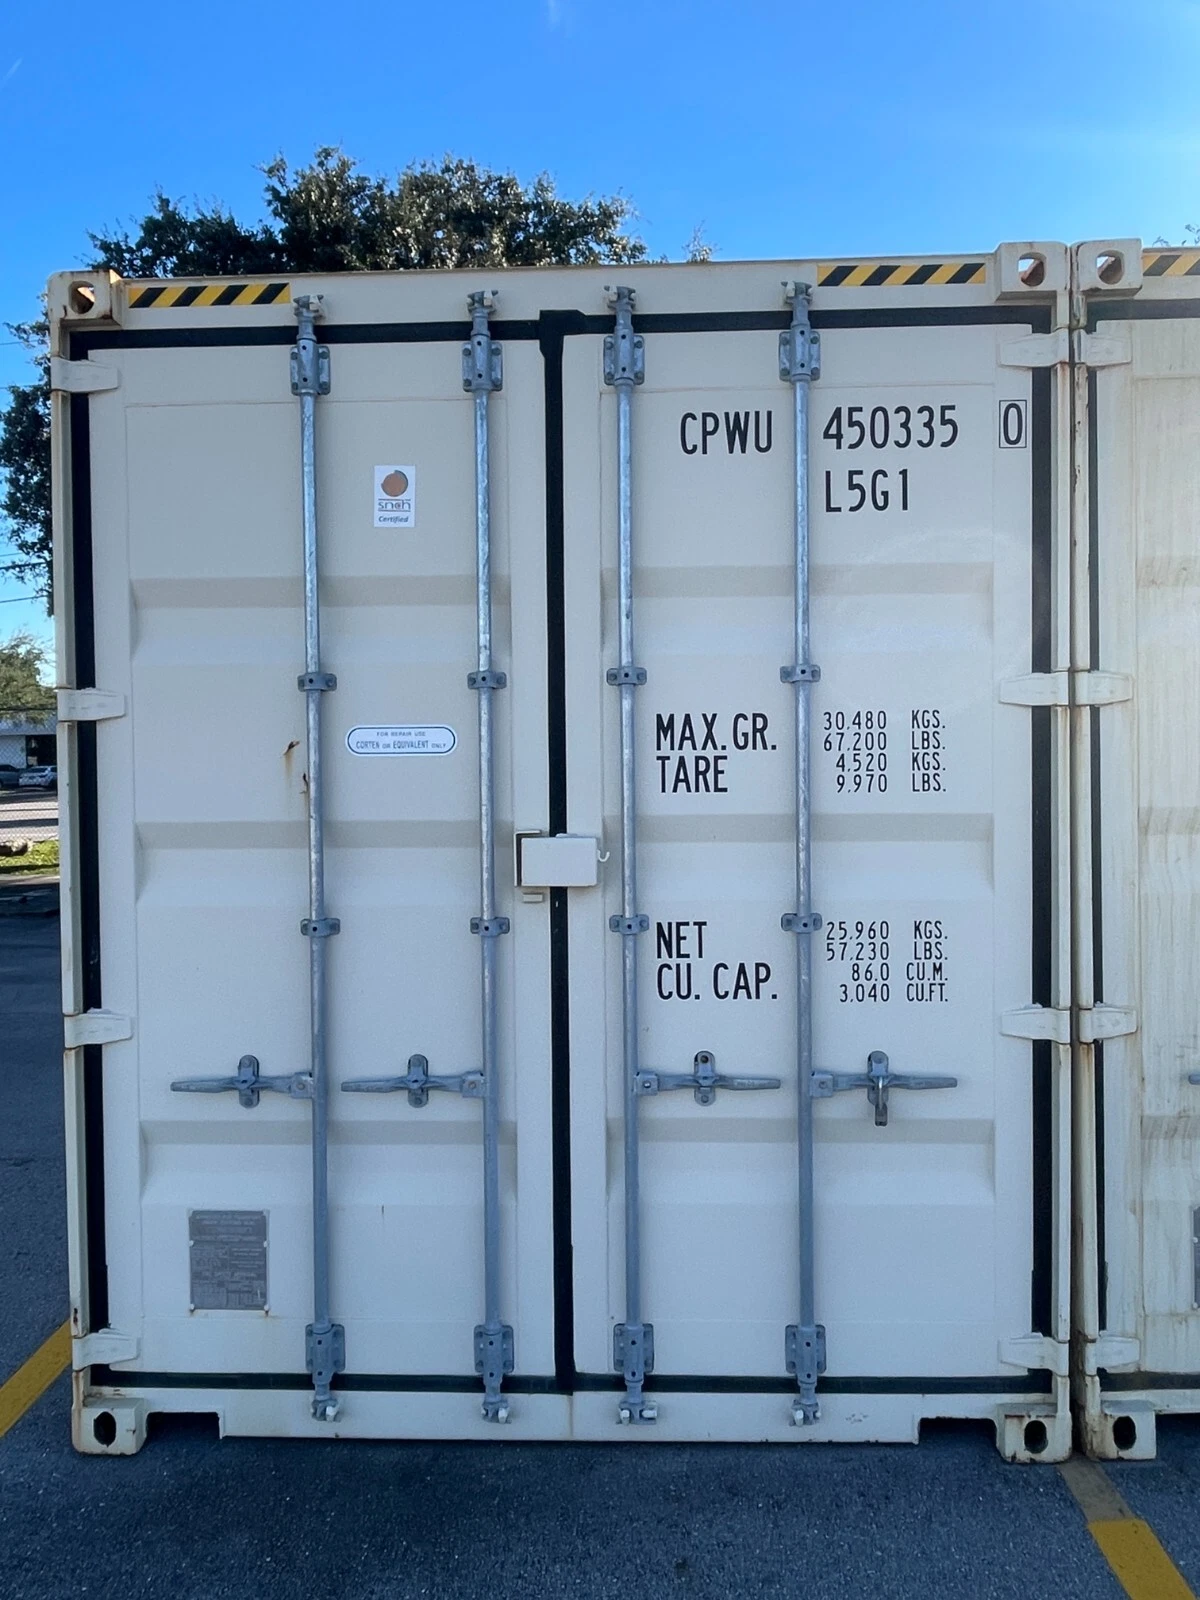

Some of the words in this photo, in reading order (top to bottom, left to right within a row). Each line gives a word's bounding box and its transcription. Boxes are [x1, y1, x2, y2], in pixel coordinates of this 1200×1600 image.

[680, 410, 773, 455] CPWU
[822, 404, 959, 450] 450335
[1002, 402, 1024, 446] 0
[824, 468, 909, 513] L5G1
[378, 515, 409, 523] Certified
[911, 709, 946, 730] KGS.
[355, 740, 380, 750] CORTEN
[392, 740, 429, 750] EQUIVALENT
[911, 730, 946, 750] LBS.
[911, 751, 947, 772] KGS.
[655, 754, 729, 794] TARE
[911, 772, 947, 793] LBS.
[655, 920, 708, 960] NET
[913, 920, 948, 940] KGS.
[913, 940, 949, 961] LBS.
[656, 962, 701, 1001] CU.
[712, 962, 778, 1000] CAP.
[851, 962, 890, 982] 86.0
[906, 961, 949, 982] CU.M.
[906, 982, 949, 1003] CU.FT.
